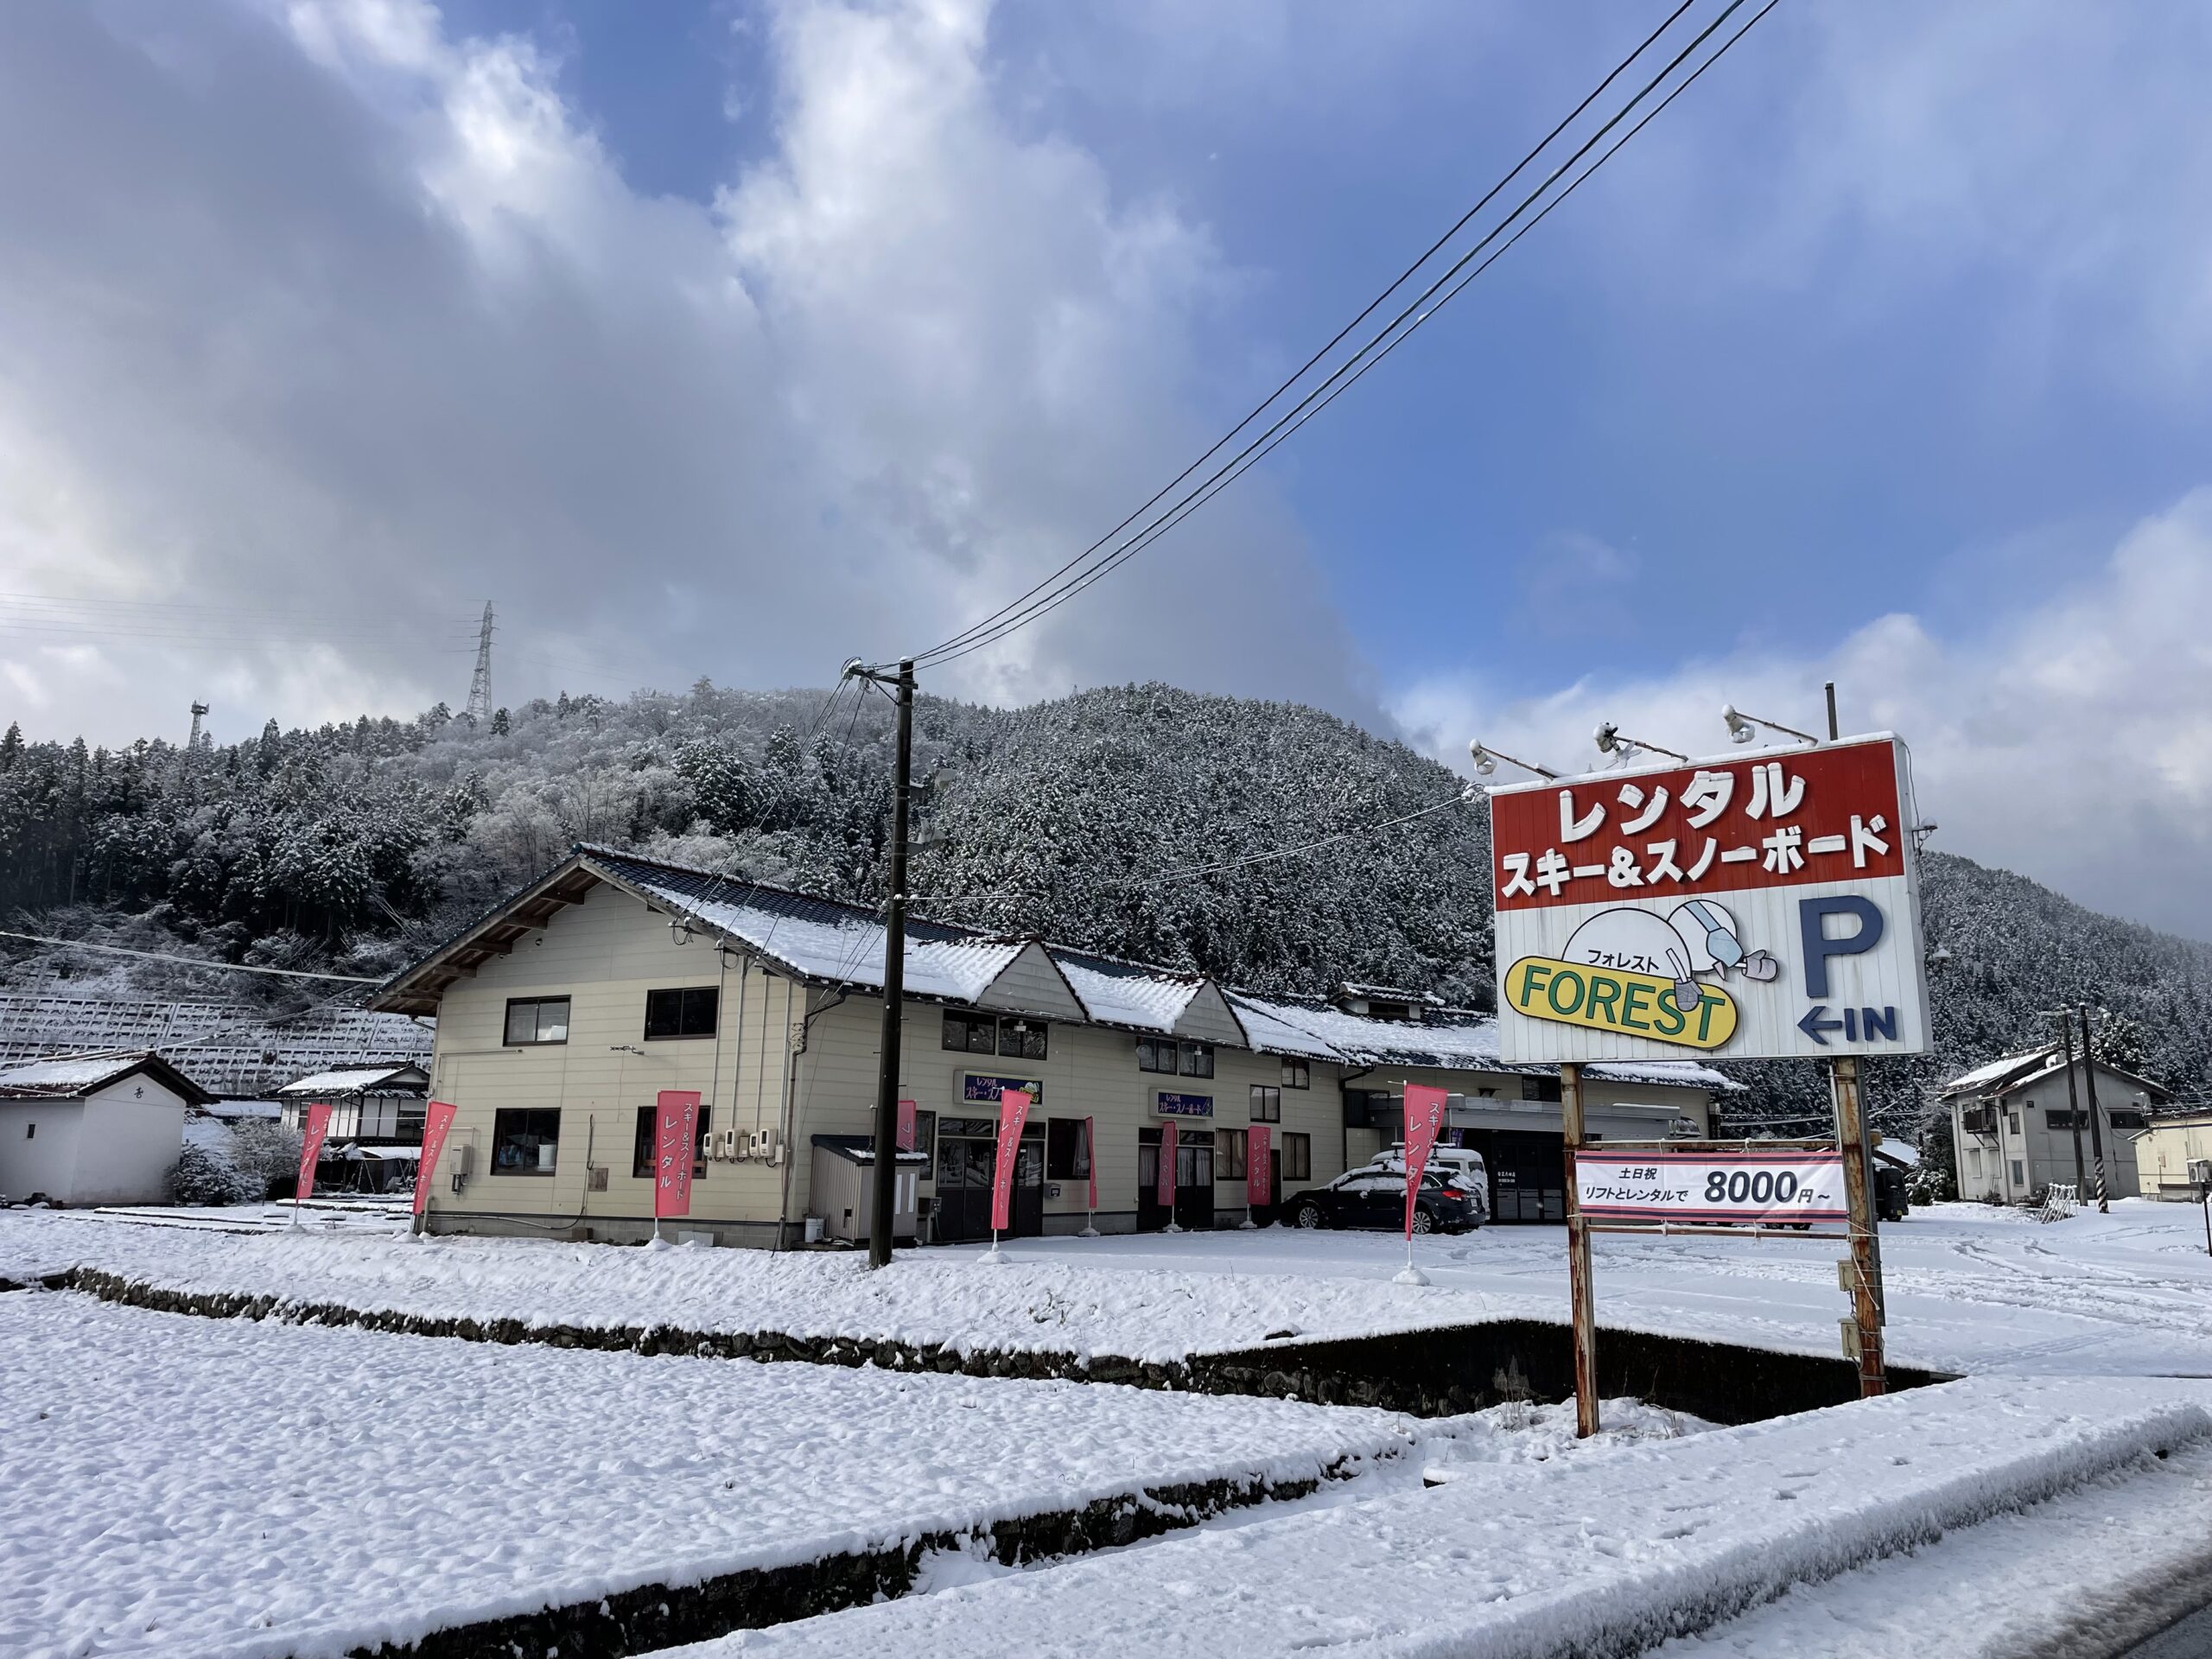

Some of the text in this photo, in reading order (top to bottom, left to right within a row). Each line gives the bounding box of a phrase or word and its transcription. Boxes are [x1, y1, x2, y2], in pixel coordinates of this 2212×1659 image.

[1559, 762, 1806, 843] レンタル
[1502, 815, 1890, 898] スキー&スノーボード
[1588, 950, 1659, 973] フォレスト
[1799, 894, 1884, 999] P
[1520, 964, 1726, 1042] FOREST
[1844, 1006, 1897, 1041] IN
[660, 1116, 677, 1188] レンタル
[1618, 1167, 1657, 1180] 土日祝
[1586, 1186, 1688, 1202] リフトとレンタルで
